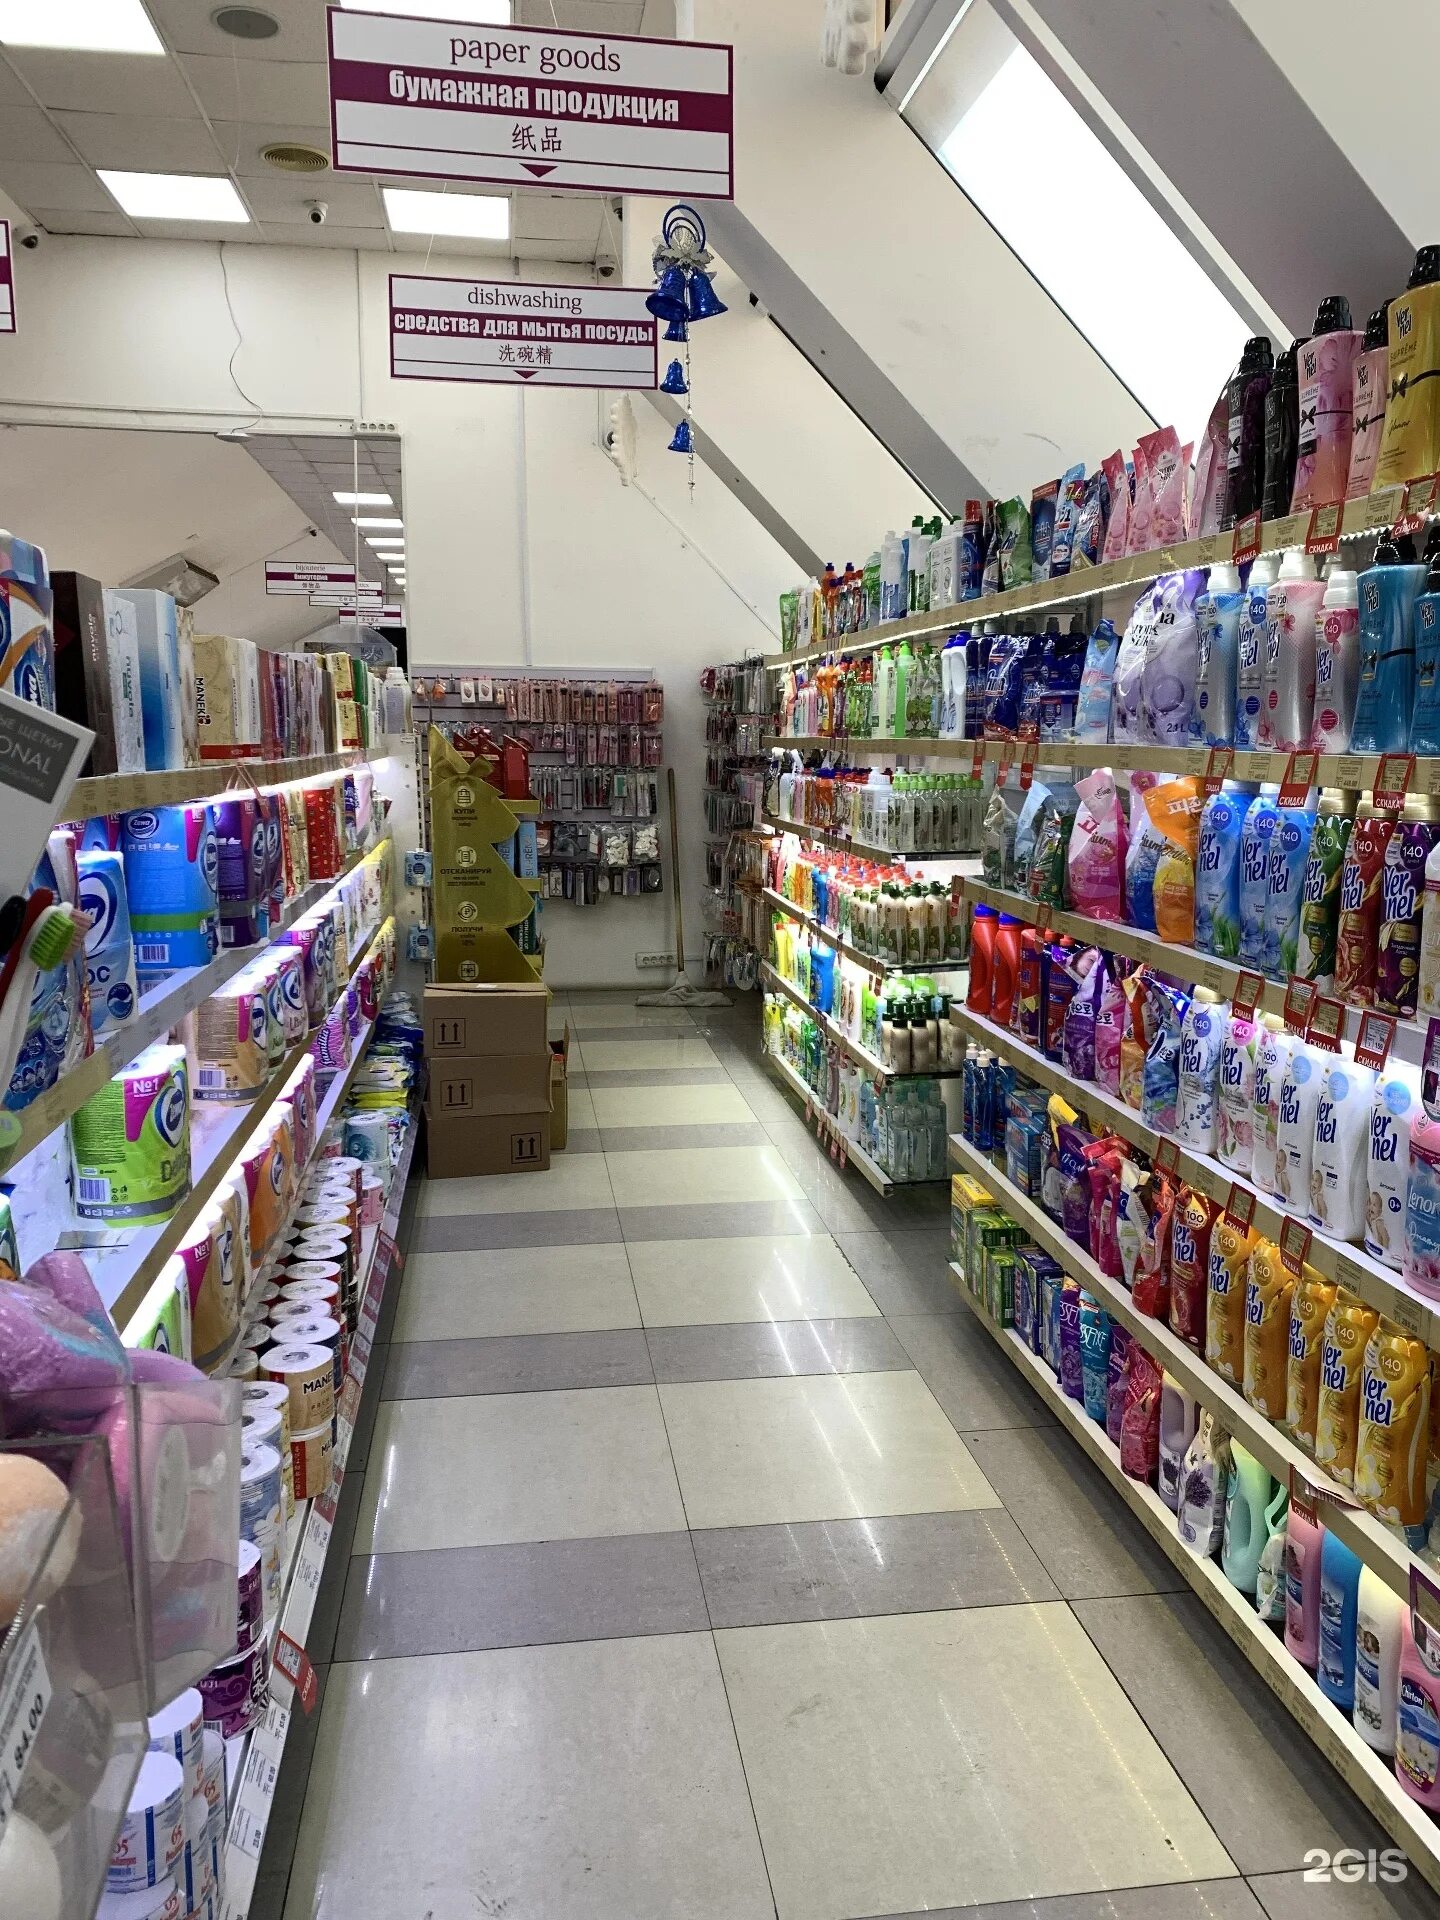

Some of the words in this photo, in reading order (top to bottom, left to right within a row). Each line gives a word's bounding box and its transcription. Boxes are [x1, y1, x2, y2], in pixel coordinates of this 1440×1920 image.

[449, 37, 530, 68] paper
[539, 46, 621, 75] goods
[389, 70, 529, 109] бумажная
[535, 87, 679, 122] продукция
[511, 124, 562, 153] 纸品
[468, 287, 582, 313] dishwashing
[394, 313, 480, 334] средства
[483, 318, 518, 337] для
[522, 320, 581, 339] мытья
[585, 324, 653, 342] посуды
[499, 345, 553, 364] 洗碗精
[1235, 549, 1257, 564] СКИДКА
[1308, 543, 1333, 554] СКИДКА
[1364, 582, 1376, 601] Ver
[1368, 591, 1379, 613] nel
[1251, 604, 1266, 614] 140
[1420, 602, 1432, 619] Ver
[1424, 609, 1435, 629] nel
[1325, 624, 1339, 634] 140
[1317, 649, 1330, 668] Ver
[1318, 658, 1332, 685] nel
[1278, 796, 1304, 806] СКИДКА
[1375, 797, 1401, 809] СКИДКА
[1211, 811, 1228, 821] 140
[1255, 818, 1275, 828] 140
[1281, 831, 1298, 842] 140
[1317, 836, 1334, 847] 140
[1355, 840, 1373, 852] 140
[1200, 846, 1220, 872] nel
[1242, 837, 1262, 863] Ver
[1402, 846, 1424, 858] 140
[440, 867, 492, 875] ОТСКАНИРУЙ
[1244, 855, 1267, 883] nel
[1269, 868, 1289, 895] nel
[1305, 875, 1325, 902] nel
[1384, 867, 1410, 897] Ver
[1342, 881, 1364, 910] nel
[1387, 888, 1415, 920] nel
[1194, 1019, 1209, 1029] 140
[1233, 1026, 1250, 1037] 140
[317, 1028, 337, 1066] familia
[1181, 1032, 1198, 1055] Ver
[1182, 1052, 1201, 1073] nel
[1263, 1052, 1277, 1062] 100
[1357, 1055, 1381, 1070] СКИДКА
[1222, 1062, 1242, 1085] nel
[1280, 1100, 1300, 1124] nel
[1370, 1107, 1391, 1138] Ver
[1316, 1118, 1337, 1143] nel
[1371, 1133, 1397, 1162] nel
[1389, 1199, 1401, 1209] 0+
[1408, 1186, 1440, 1214] Lenor
[1186, 1210, 1204, 1223] 100
[1175, 1240, 1195, 1263] nel
[1219, 1234, 1236, 1248] 140
[1210, 1270, 1230, 1294] nel
[1255, 1264, 1270, 1278] 140
[1336, 1324, 1355, 1340] 140
[1289, 1337, 1306, 1361] nel
[1381, 1355, 1401, 1372] 140
[1323, 1366, 1346, 1392] nel
[1363, 1365, 1388, 1399] Ver
[1365, 1399, 1392, 1426] nel
[1402, 1684, 1423, 1706] Chirton
[171, 1824, 183, 1846] 65
